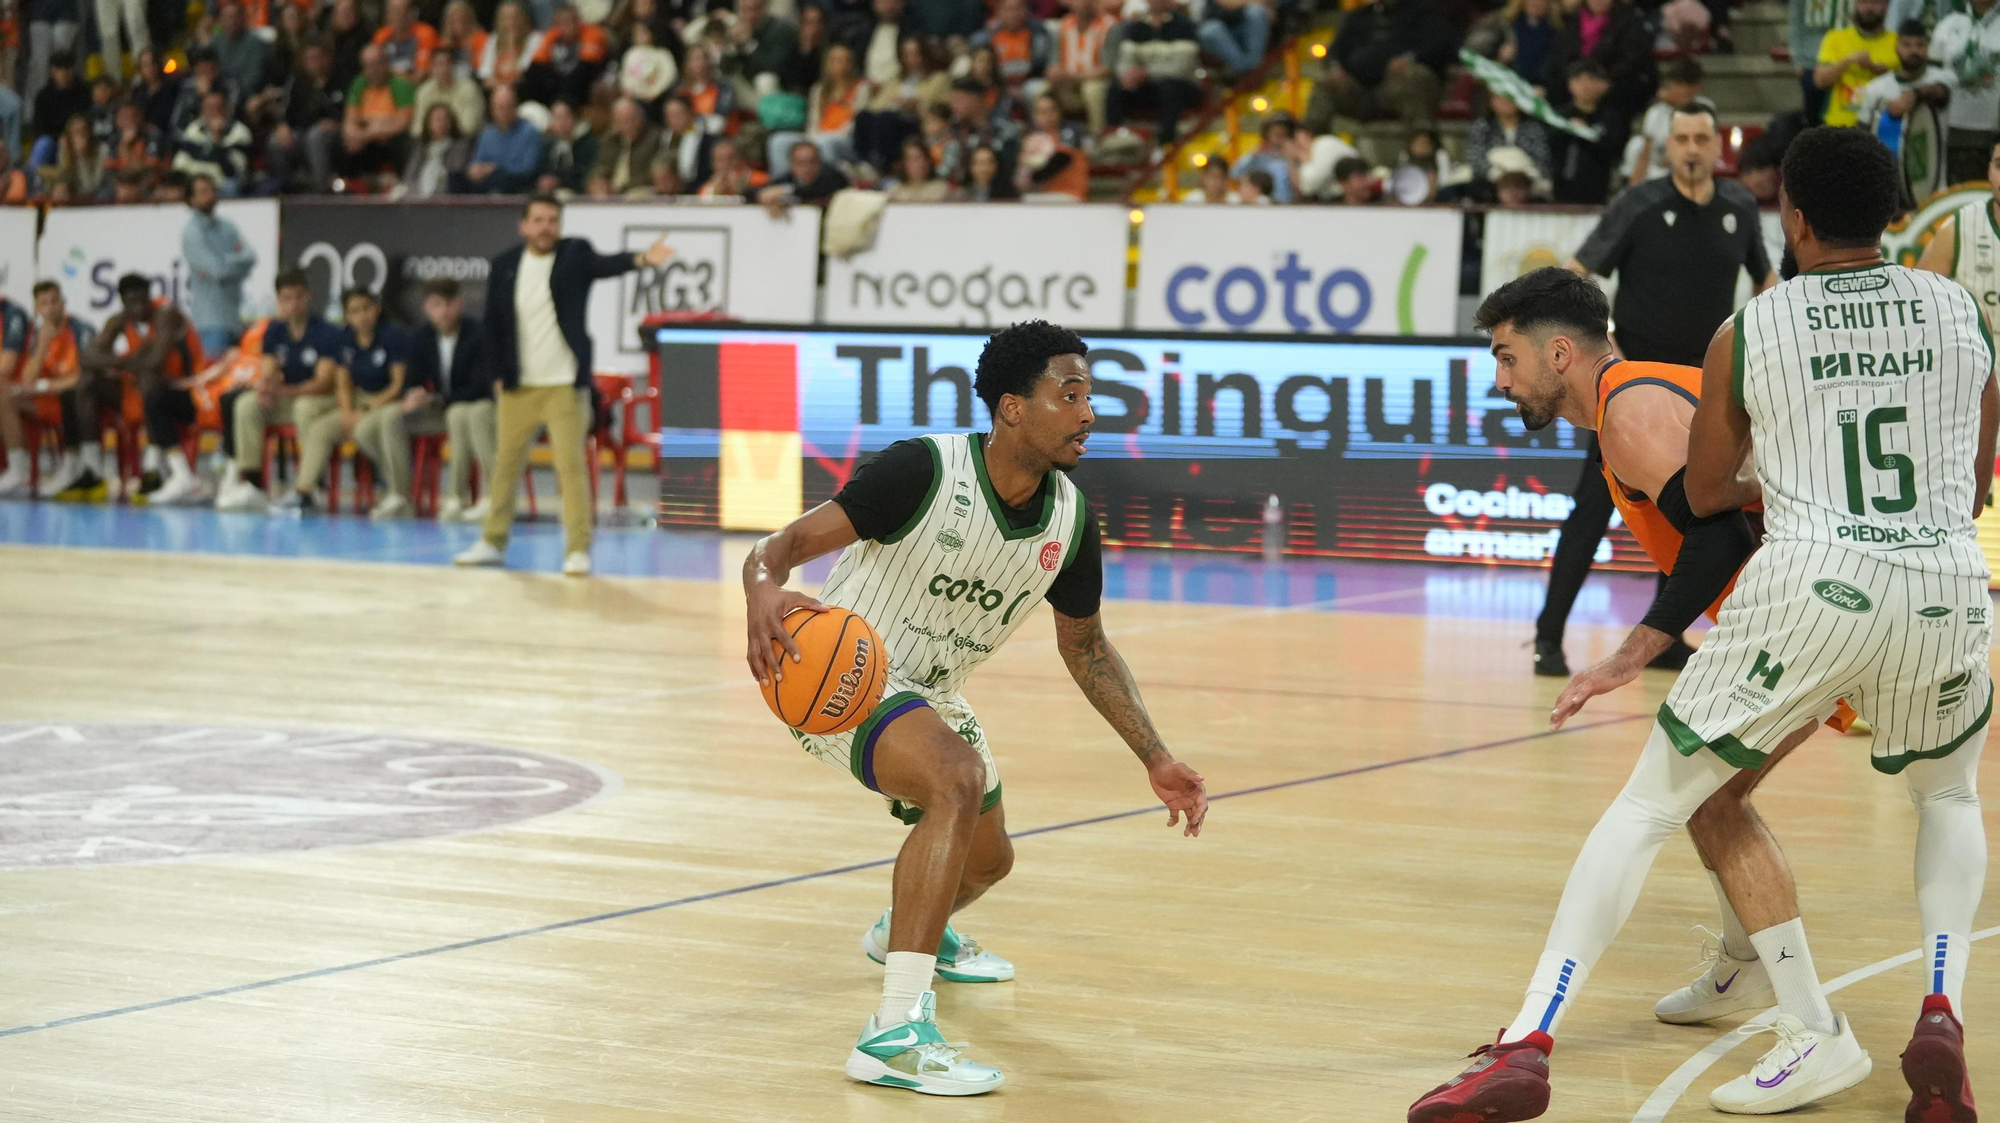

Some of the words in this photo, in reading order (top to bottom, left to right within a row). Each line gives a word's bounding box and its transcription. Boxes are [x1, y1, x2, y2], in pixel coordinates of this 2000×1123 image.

[853, 265, 1096, 327] neogare
[1166, 252, 1372, 334] coto
[1806, 300, 1926, 331] SCHUTTE
[1857, 348, 1934, 377] RAHI
[836, 344, 973, 427] Th
[1813, 380, 1860, 392] SOLUCIONES
[1838, 410, 1857, 424] CCB
[1838, 406, 1918, 516] 15
[1424, 483, 1577, 520] Cocina
[928, 573, 1004, 612] coto
[1821, 583, 1862, 610] Ford
[1919, 619, 1950, 629] TYSA
[820, 638, 869, 718] Wilson
[1733, 683, 1774, 706] Hospital
